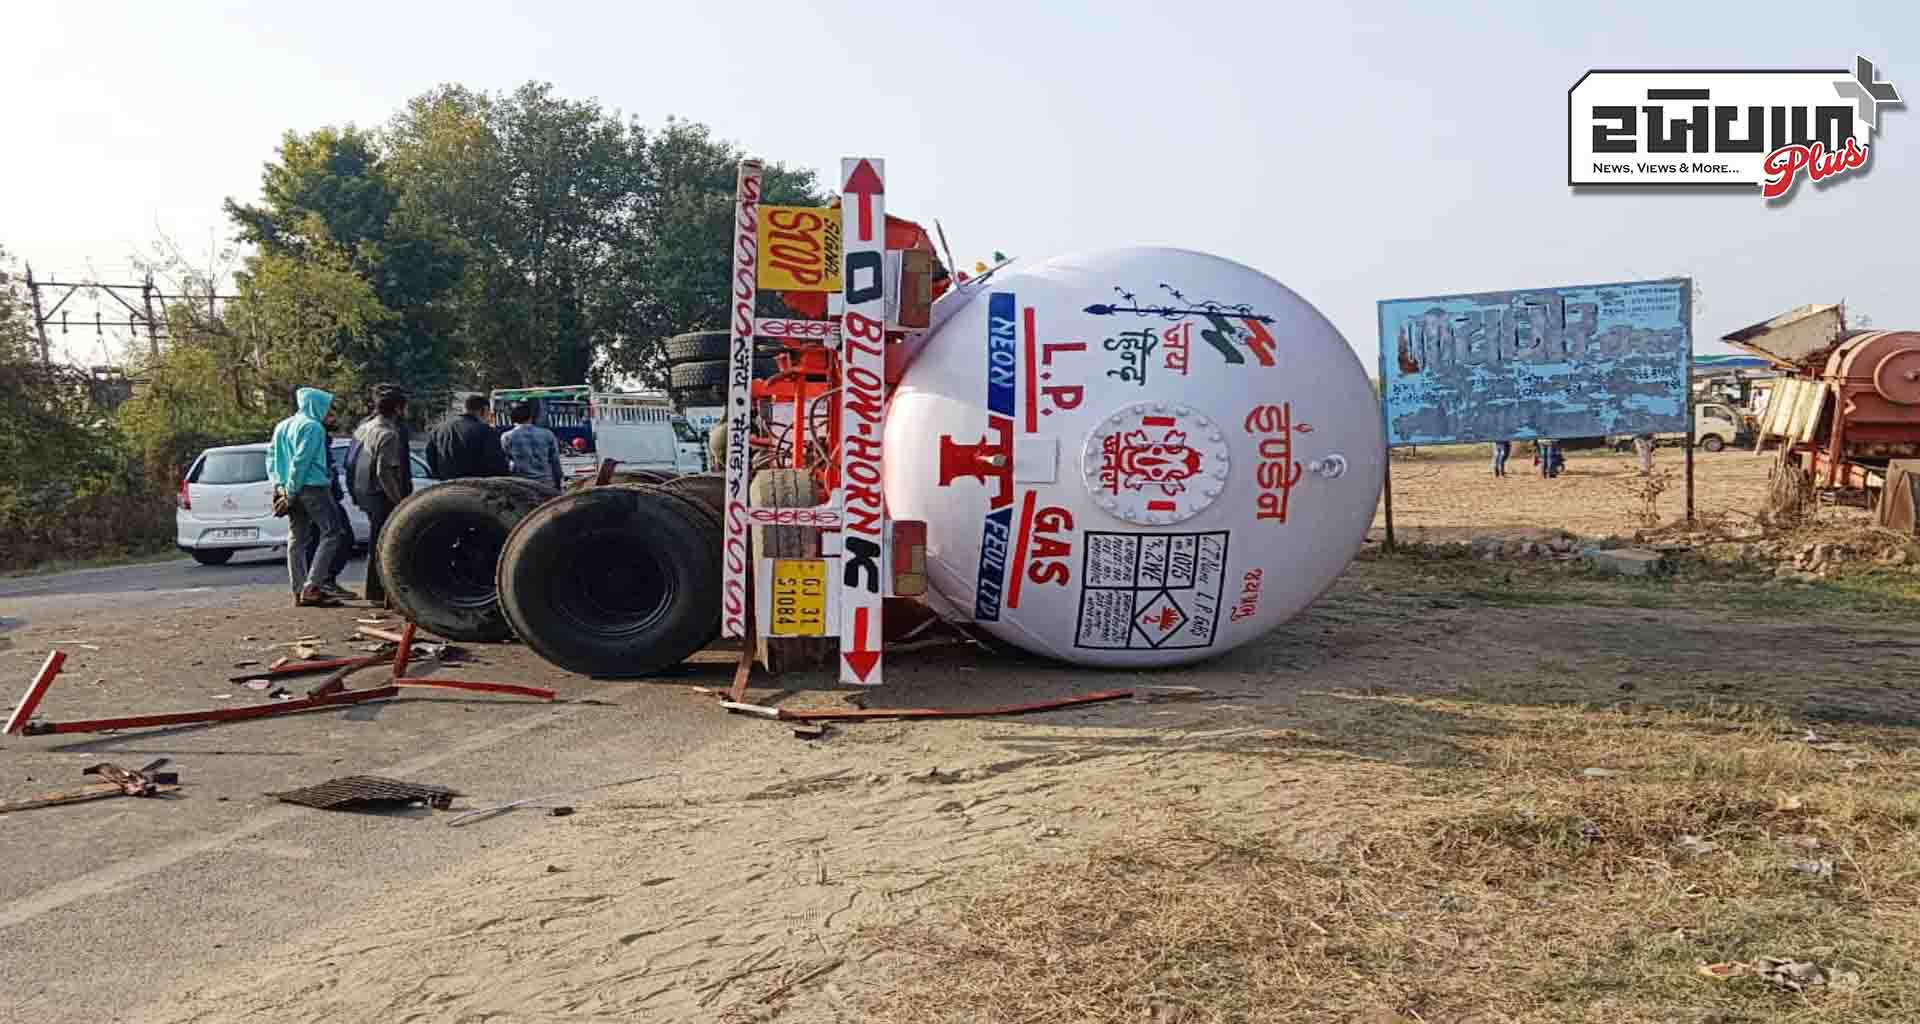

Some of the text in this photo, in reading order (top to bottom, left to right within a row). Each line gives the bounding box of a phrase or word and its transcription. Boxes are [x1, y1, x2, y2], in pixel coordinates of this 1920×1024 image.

[768, 210, 823, 287] STOP
[824, 217, 841, 280] SIGNAL
[990, 317, 1015, 388] NEON
[1103, 328, 1160, 387] हिन्द
[1162, 322, 1194, 375] जय
[1028, 342, 1087, 587] L.P. GAS
[1099, 432, 1121, 496] खतरा
[983, 519, 1008, 571] FEUL
[1172, 551, 1192, 580] 1075
[800, 578, 821, 624] GJ 31
[1142, 615, 1160, 625] 2
